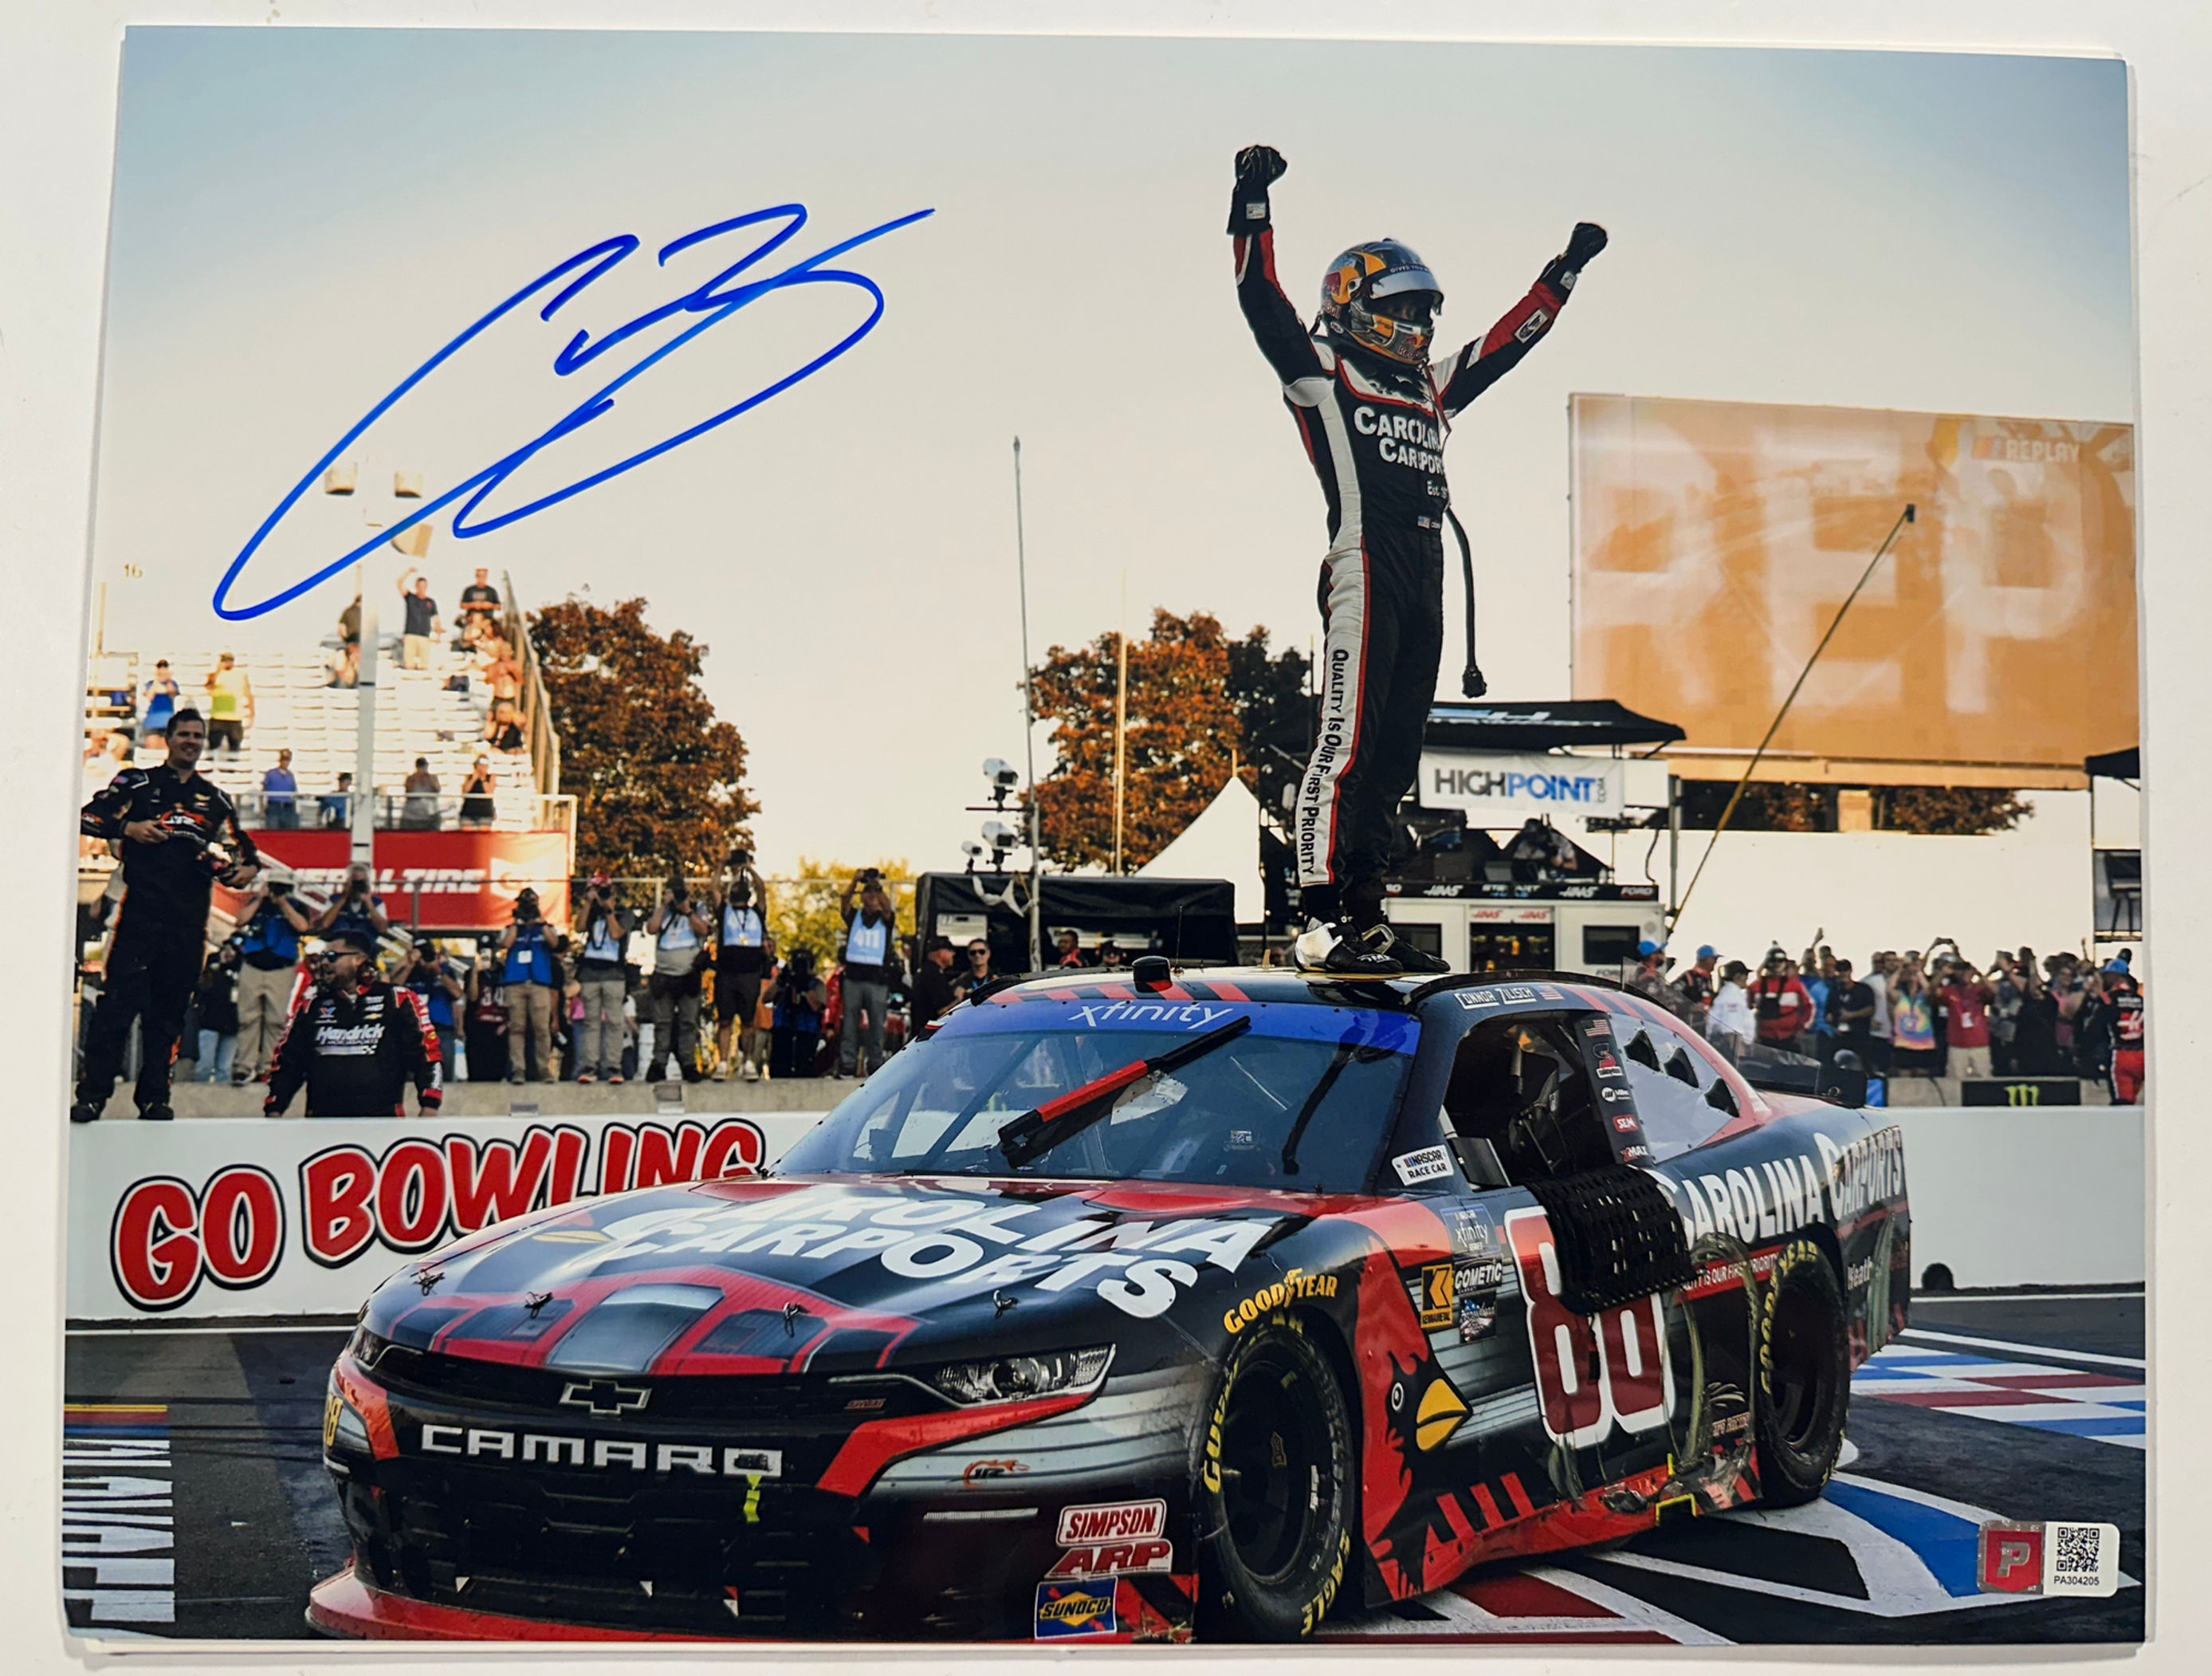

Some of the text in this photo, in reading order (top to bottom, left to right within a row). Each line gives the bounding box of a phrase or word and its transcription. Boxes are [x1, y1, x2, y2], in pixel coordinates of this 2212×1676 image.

[1379, 438, 1444, 474] CARPOR
[2006, 439, 2080, 462] REPLAY
[124, 563, 143, 580] 16
[1301, 649, 1349, 874] QUALITY IS OUR FIRST PRIORITY
[1435, 768, 1597, 803] HIGHPOINT
[403, 868, 488, 894] TIRE
[1454, 990, 1500, 1009] CONNOR
[1067, 999, 1235, 1030] xfinity
[316, 1022, 386, 1045] Hendrick
[1408, 1163, 1448, 1179] RACE CAR
[1409, 1150, 1444, 1167] NASCAR
[1813, 1126, 1903, 1221] CARPORTS
[110, 1118, 766, 1312] GO BOWLING
[1456, 1221, 1488, 1249] xfinity
[1454, 1262, 1503, 1290] COMETIC
[1712, 1265, 1727, 1285] OUR
[1728, 1261, 1745, 1280] FIRS
[1224, 1268, 1338, 1334] GOODYEAR
[421, 1423, 783, 1477] CAMARO
[1066, 1507, 1157, 1540] SIMPSON
[1049, 1540, 1170, 1575] ARP
[2053, 1575, 2100, 1586] PA304205
[1039, 1596, 1111, 1619] SUNOCO
